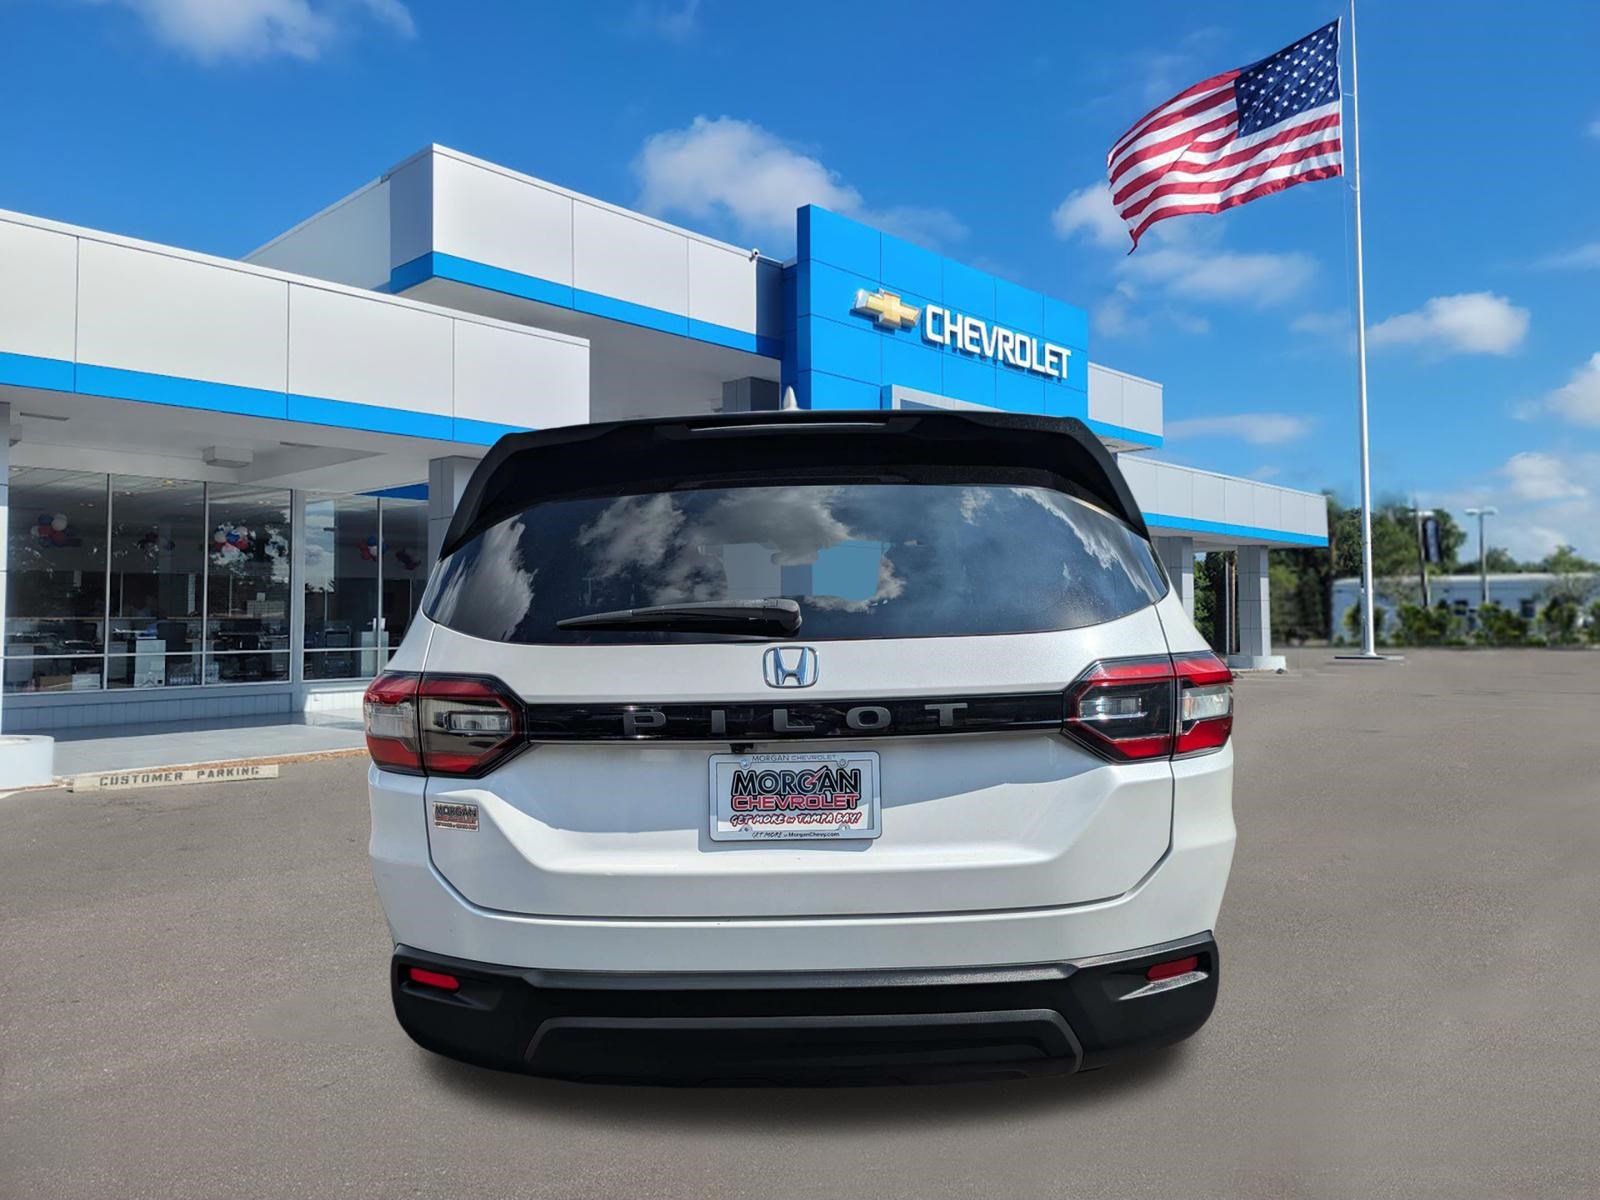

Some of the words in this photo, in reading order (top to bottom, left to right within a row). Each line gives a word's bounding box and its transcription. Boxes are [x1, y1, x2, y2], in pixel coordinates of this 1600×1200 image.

[924, 303, 1072, 379] CHEVROLET
[623, 703, 968, 737] PILOT
[752, 754, 790, 762] MORGAN
[99, 771, 184, 787] CUSTOMER
[196, 766, 261, 779] PARKING
[732, 766, 861, 795] MORGAN
[731, 794, 861, 811] CHEVROLET
[730, 814, 754, 827] GET
[752, 813, 785, 825] MORE
[796, 813, 833, 824] TAMPA
[834, 812, 862, 824] BAY!
